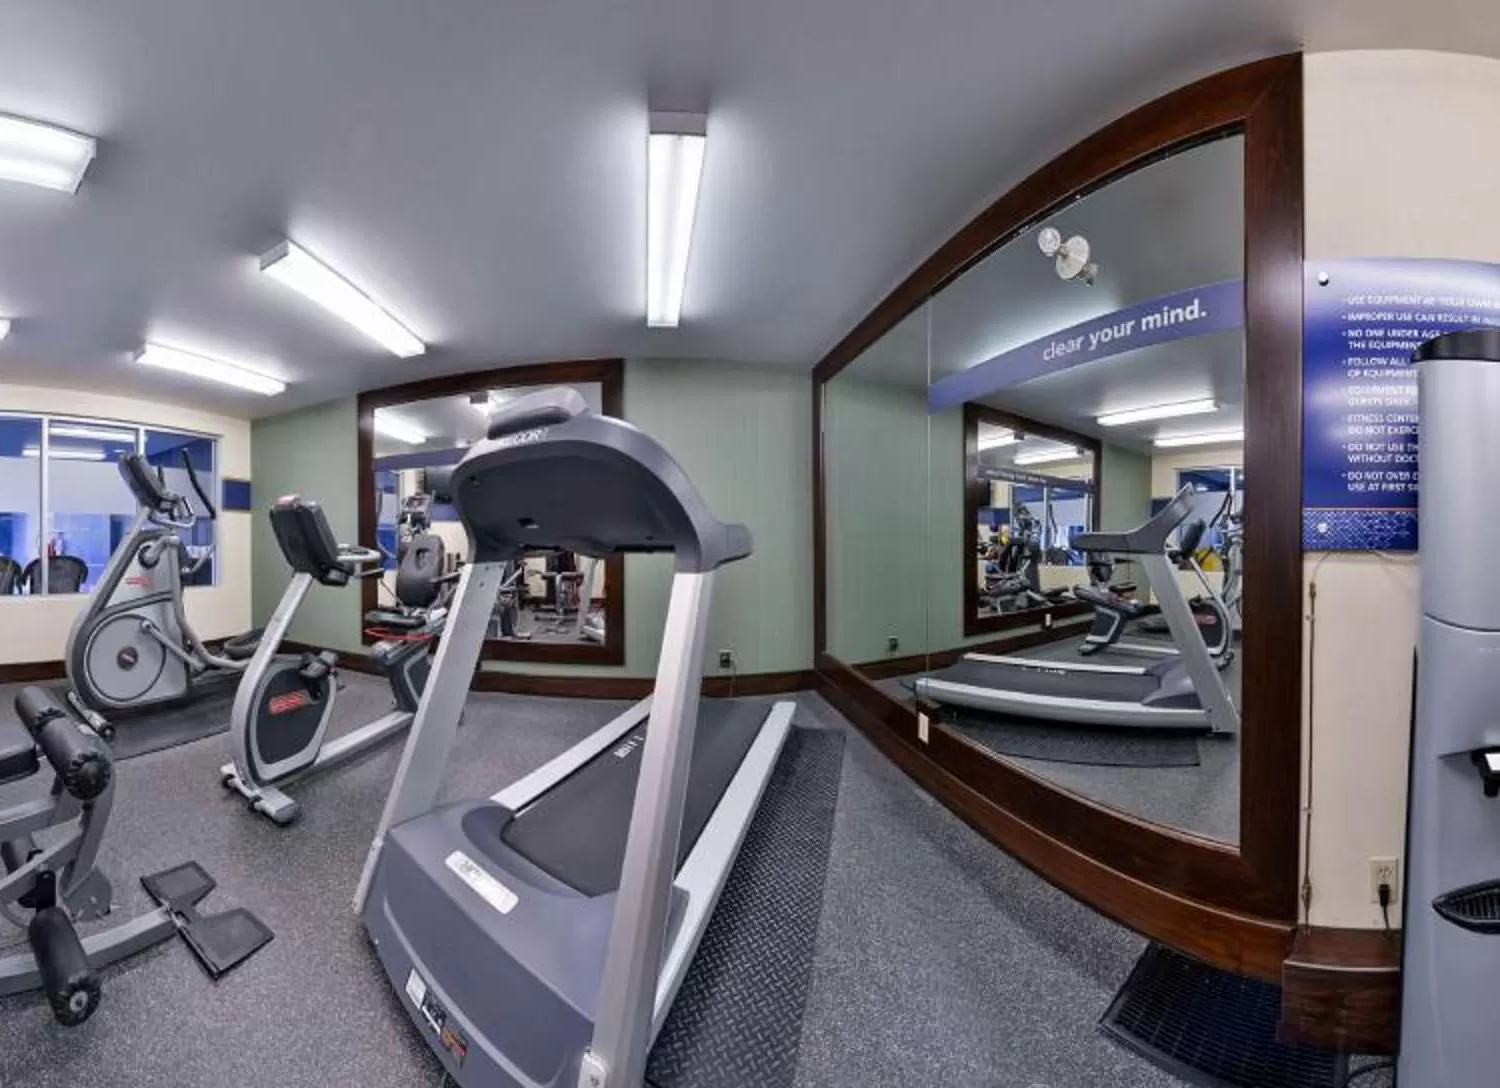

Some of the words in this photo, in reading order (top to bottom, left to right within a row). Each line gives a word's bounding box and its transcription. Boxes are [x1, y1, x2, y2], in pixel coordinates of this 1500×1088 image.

[1367, 295, 1421, 306] EQUIPMENT
[1347, 312, 1394, 321] IMPROPER
[1395, 312, 1412, 321] USE
[1415, 313, 1436, 322] CAN
[1438, 314, 1468, 324] RESULT
[1043, 333, 1084, 361] clear
[1087, 319, 1135, 350] your
[1141, 298, 1207, 331] mind.
[1348, 329, 1362, 338] NO
[1365, 329, 1385, 338] ONE
[1387, 329, 1419, 338] UNDER
[1348, 340, 1366, 350] THE
[1348, 357, 1387, 367] FOLLOW
[1389, 357, 1409, 367] ALL
[1348, 369, 1361, 377] OF
[1348, 413, 1384, 423] FITNESS
[1348, 425, 1362, 434] DO
[1364, 425, 1385, 435] NOT
[1387, 425, 1419, 435] EXERC
[1348, 443, 1362, 452] DO
[1365, 443, 1385, 452] NOT
[1387, 443, 1404, 452] USE
[1348, 454, 1393, 463] WITHOUT
[1395, 454, 1418, 463] DOC
[1348, 471, 1362, 480] DO
[1364, 471, 1384, 480] NOT
[1386, 471, 1410, 480] OVER
[1348, 482, 1365, 491] USE
[1367, 482, 1380, 491] AT
[1381, 482, 1405, 491] FIRST
